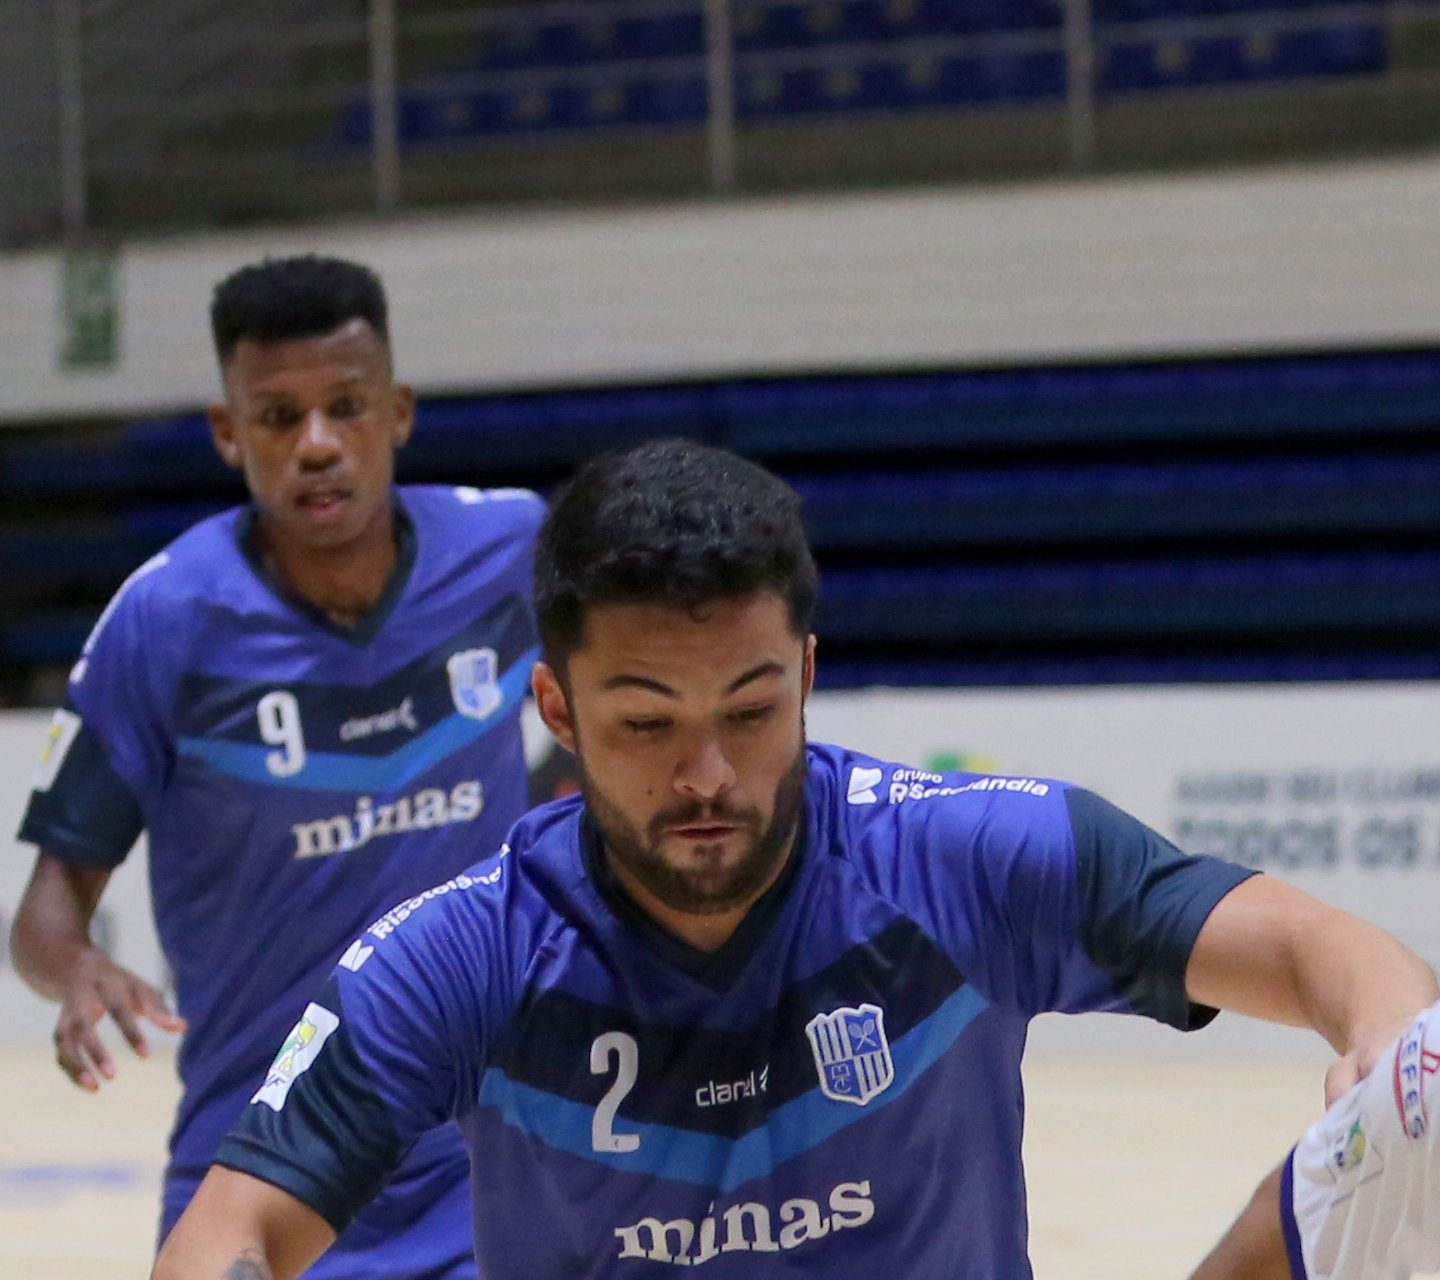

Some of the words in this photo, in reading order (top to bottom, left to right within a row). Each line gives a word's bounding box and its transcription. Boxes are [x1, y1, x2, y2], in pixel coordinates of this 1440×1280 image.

[256, 690, 307, 778] 9
[891, 768, 943, 784] Grupo
[291, 779, 485, 858] minas
[589, 1030, 640, 1152] 2
[614, 1180, 876, 1266] minas
